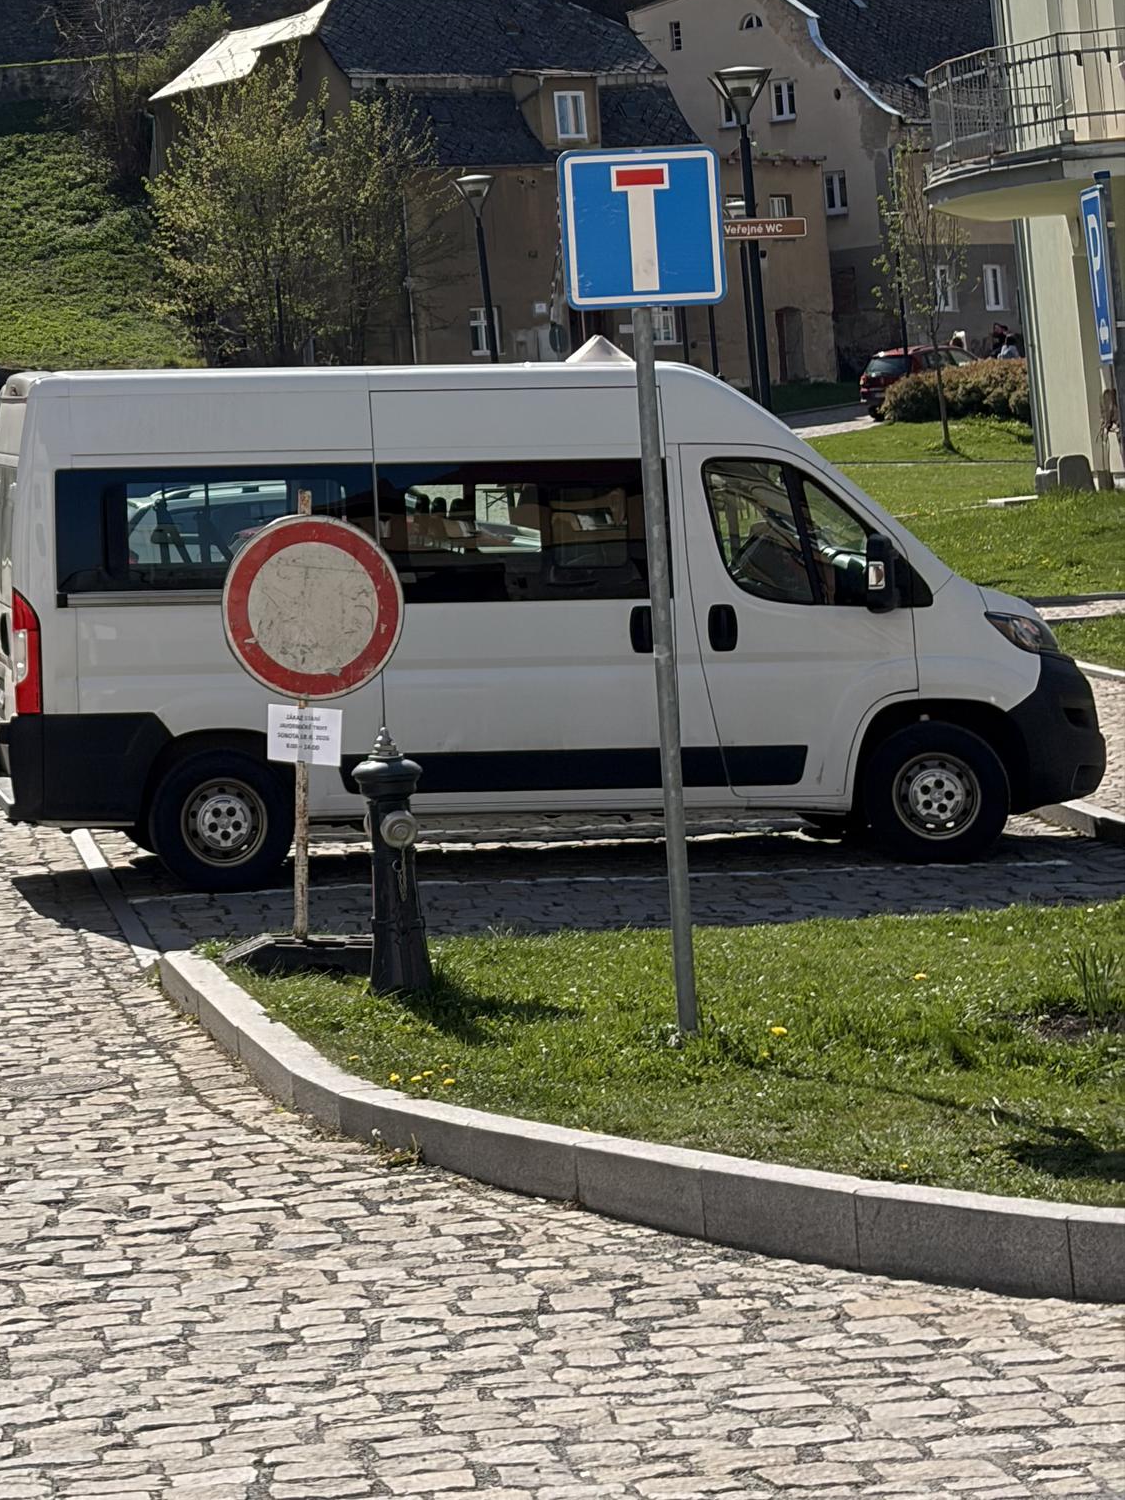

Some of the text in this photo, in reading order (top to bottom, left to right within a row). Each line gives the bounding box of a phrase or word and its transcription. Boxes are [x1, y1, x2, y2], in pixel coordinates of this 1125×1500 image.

[723, 223, 783, 235] Veřejné WC
[1087, 213, 1101, 308] P
